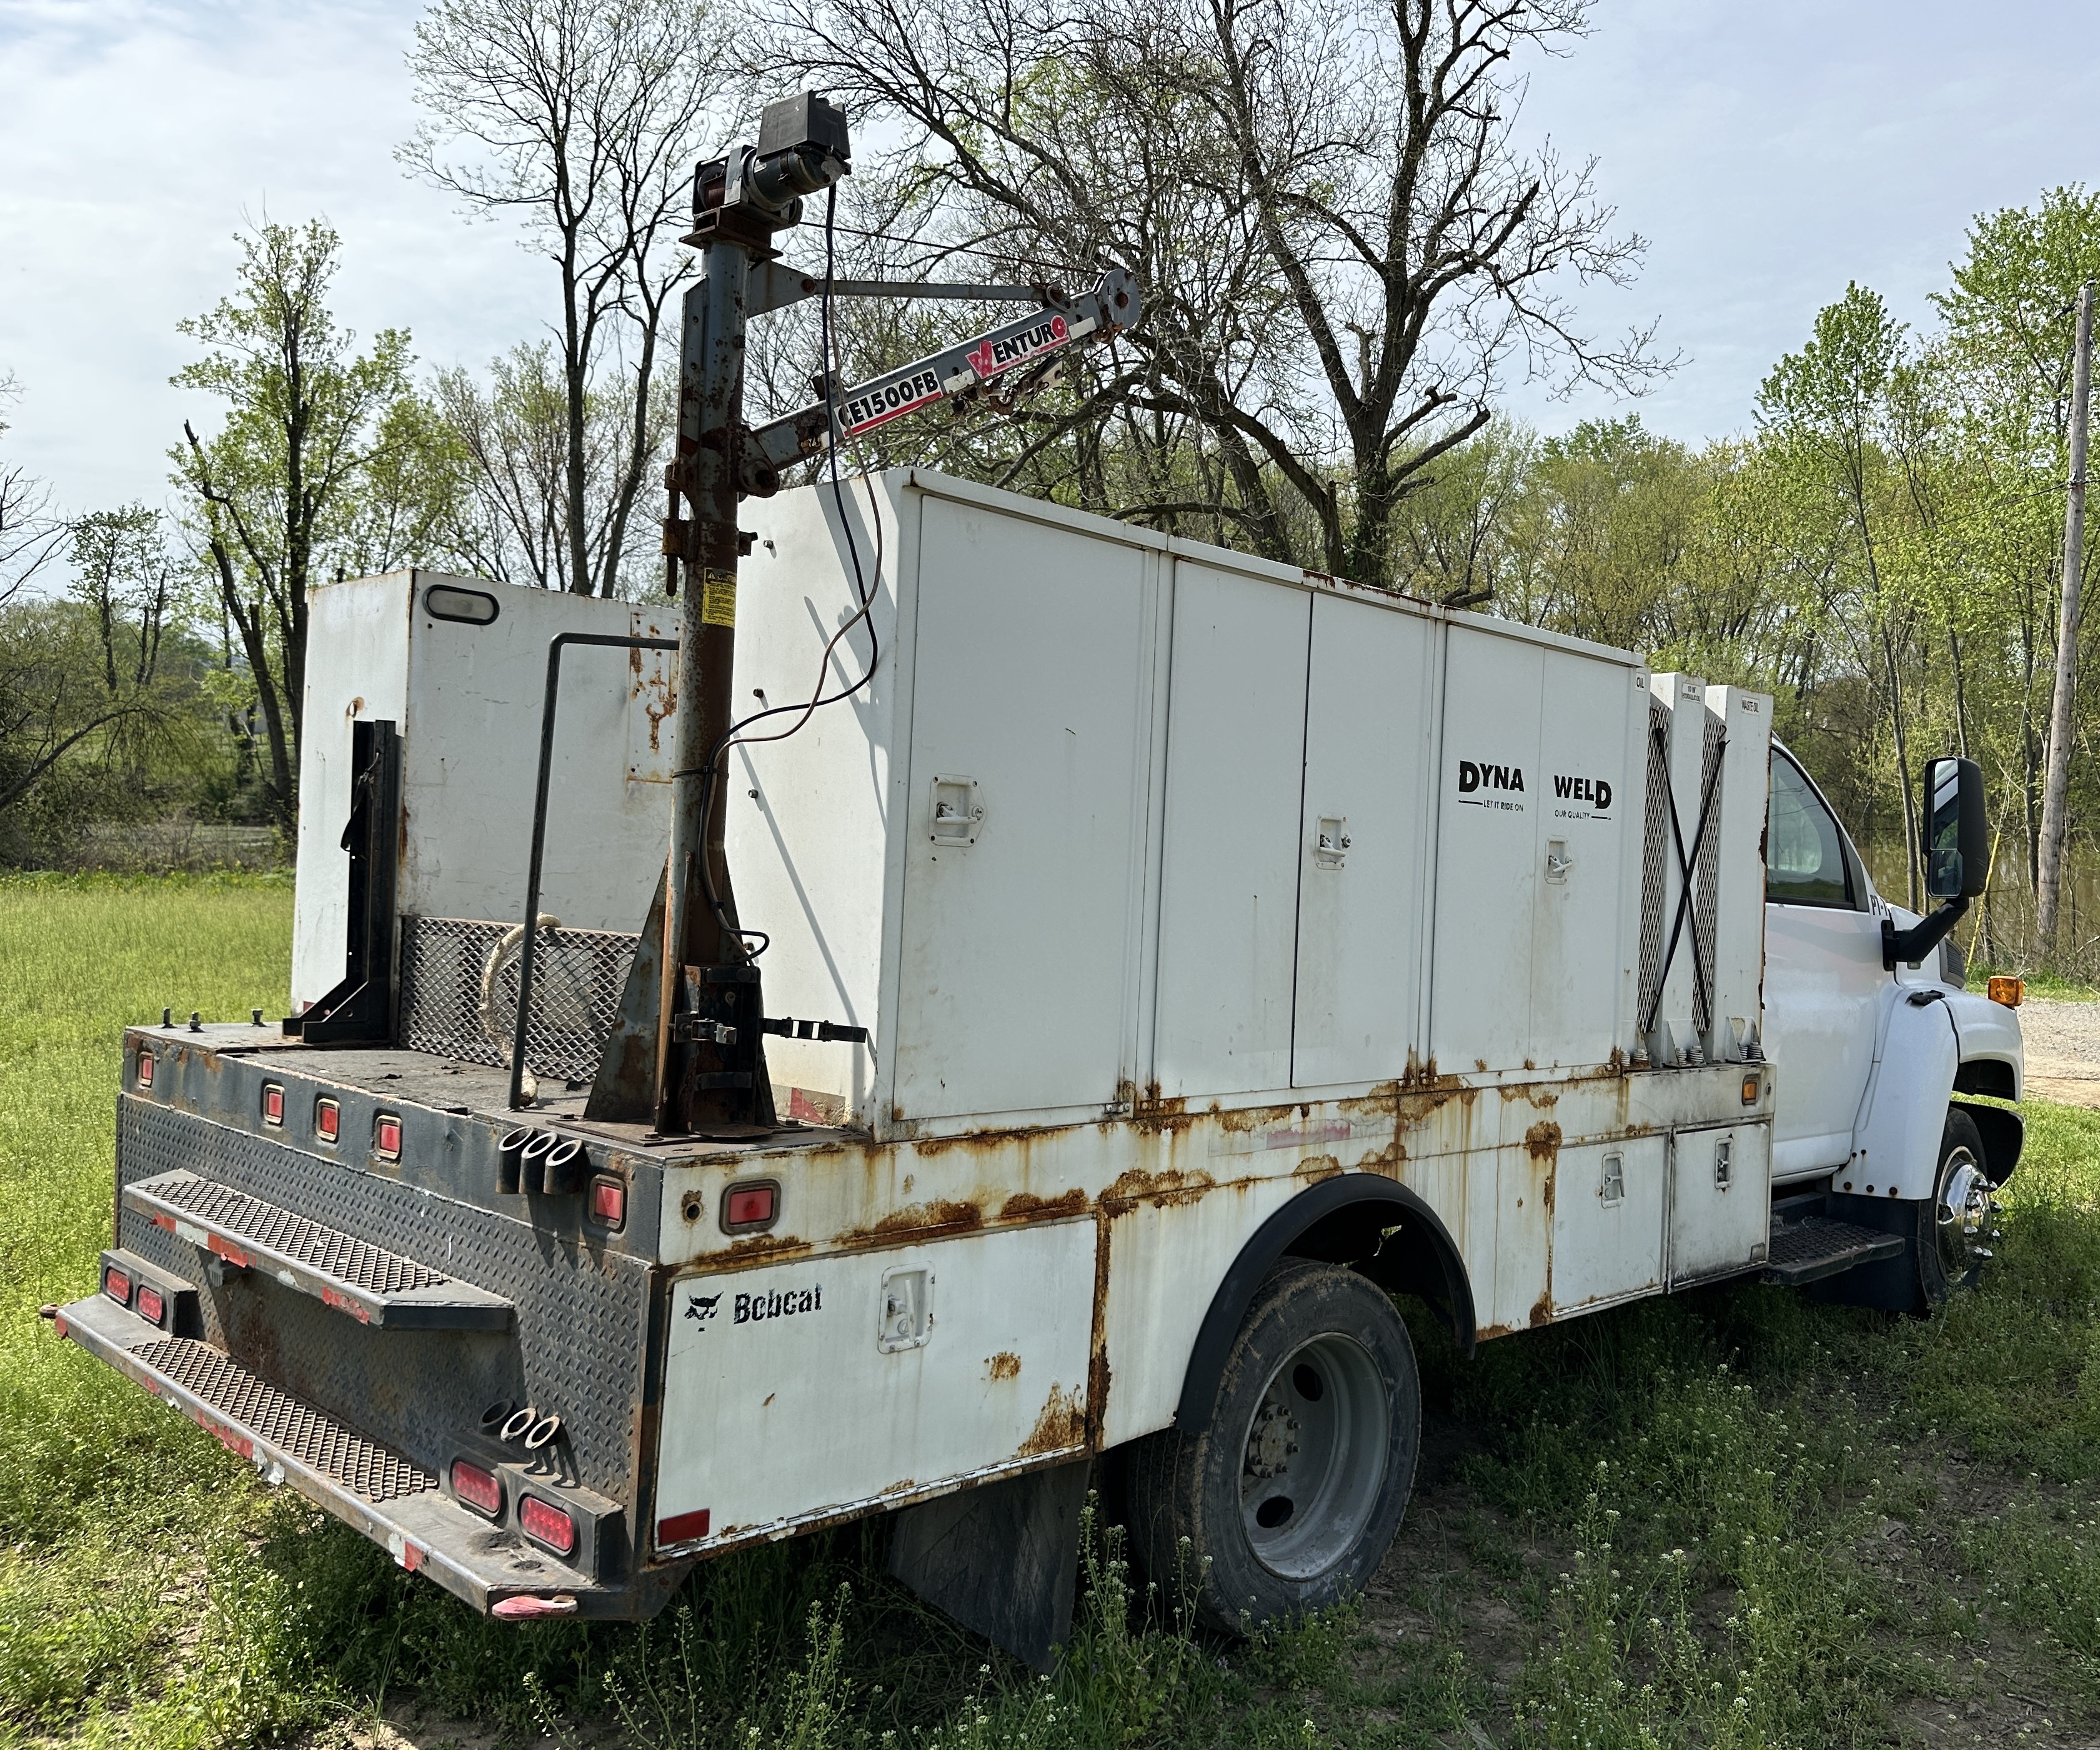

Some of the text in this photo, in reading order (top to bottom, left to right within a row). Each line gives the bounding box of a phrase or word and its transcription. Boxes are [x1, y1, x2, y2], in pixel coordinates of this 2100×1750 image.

[966, 315, 1068, 379] VENTURO
[1636, 677, 1645, 689] OIL
[1458, 760, 1525, 793] DYNA
[1554, 775, 1612, 810] WELD
[1483, 800, 1524, 812] LET IT RIDE ON
[1555, 810, 1590, 820] OUR QUALITY
